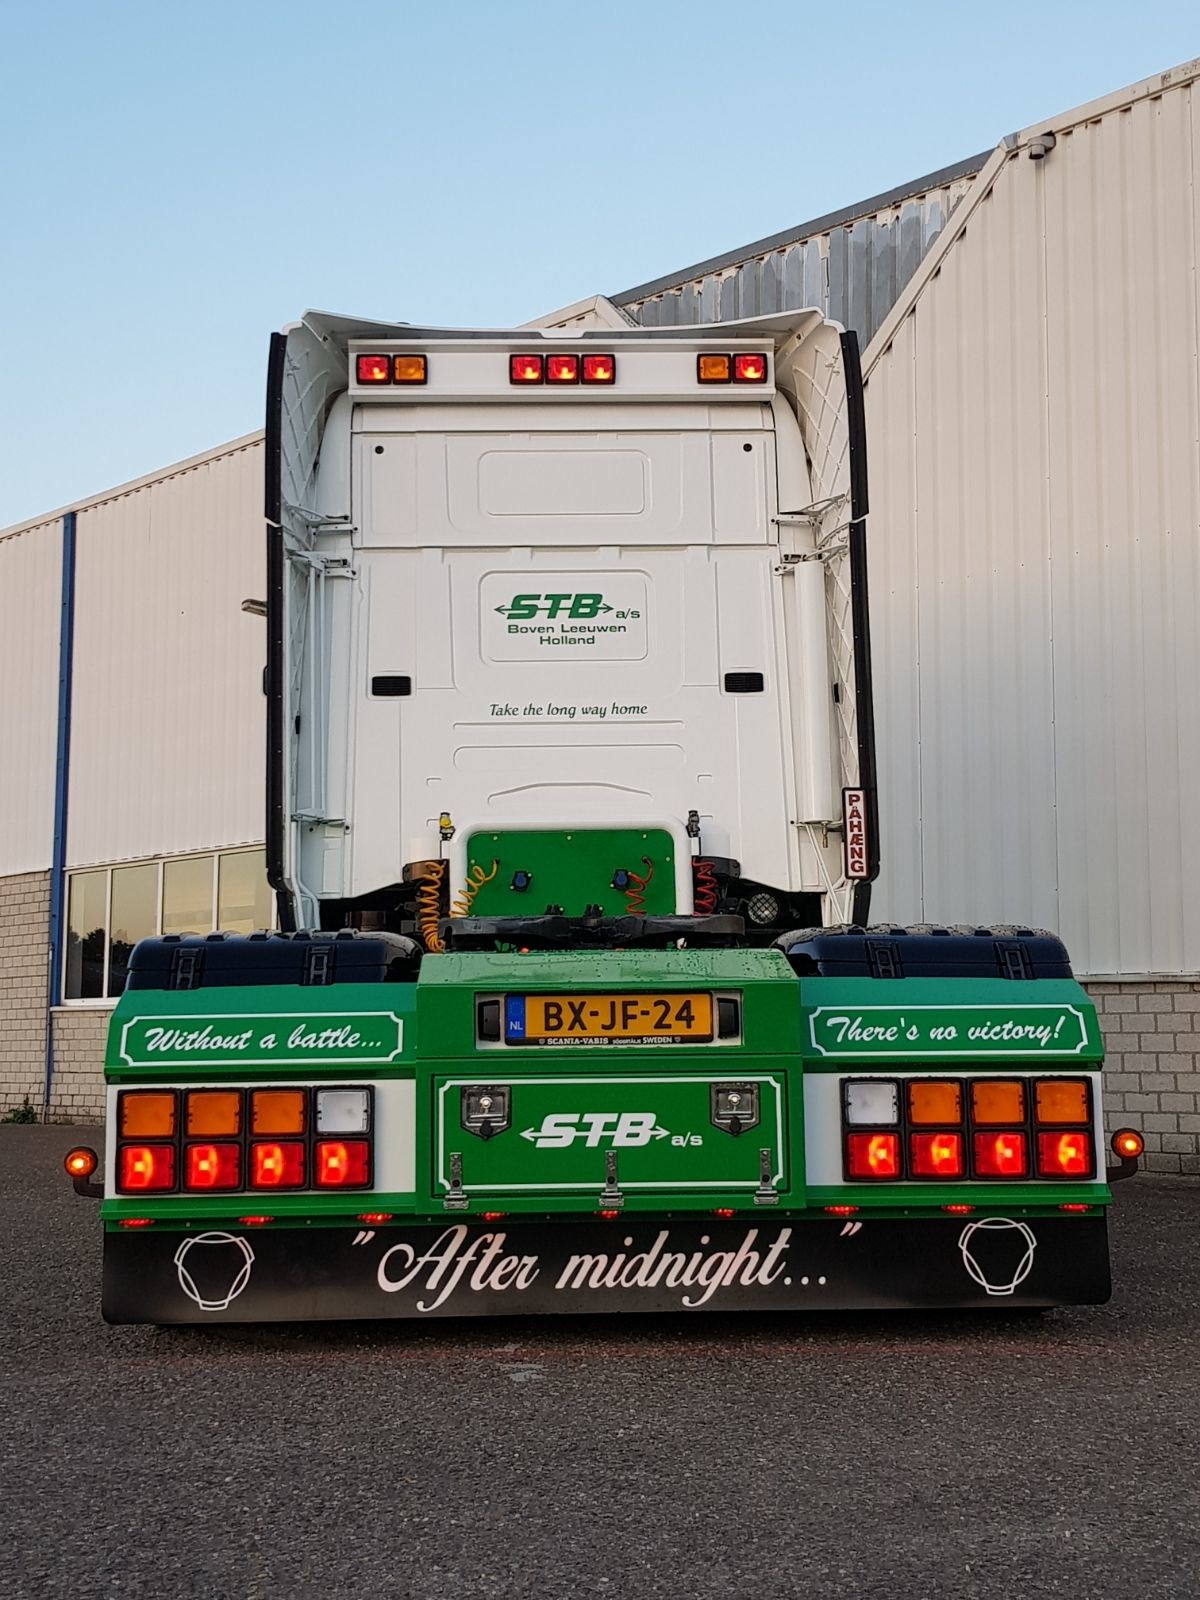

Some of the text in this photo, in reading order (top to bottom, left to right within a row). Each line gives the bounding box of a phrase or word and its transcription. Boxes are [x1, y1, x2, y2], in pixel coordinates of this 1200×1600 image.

[507, 593, 641, 620] STB a/s
[507, 624, 627, 634] Boven Leeuwen
[539, 635, 595, 645] Holland
[490, 702, 648, 719] Take the long way home
[510, 1020, 524, 1031] NL
[544, 1000, 695, 1032] BX-JF-24
[144, 1024, 382, 1052] Without a battle...
[547, 1036, 609, 1046] SCANIA-VABIS
[642, 1036, 673, 1044] SWEDEN
[826, 1015, 1066, 1047] There's no victory!
[535, 1112, 703, 1148] STB a/s
